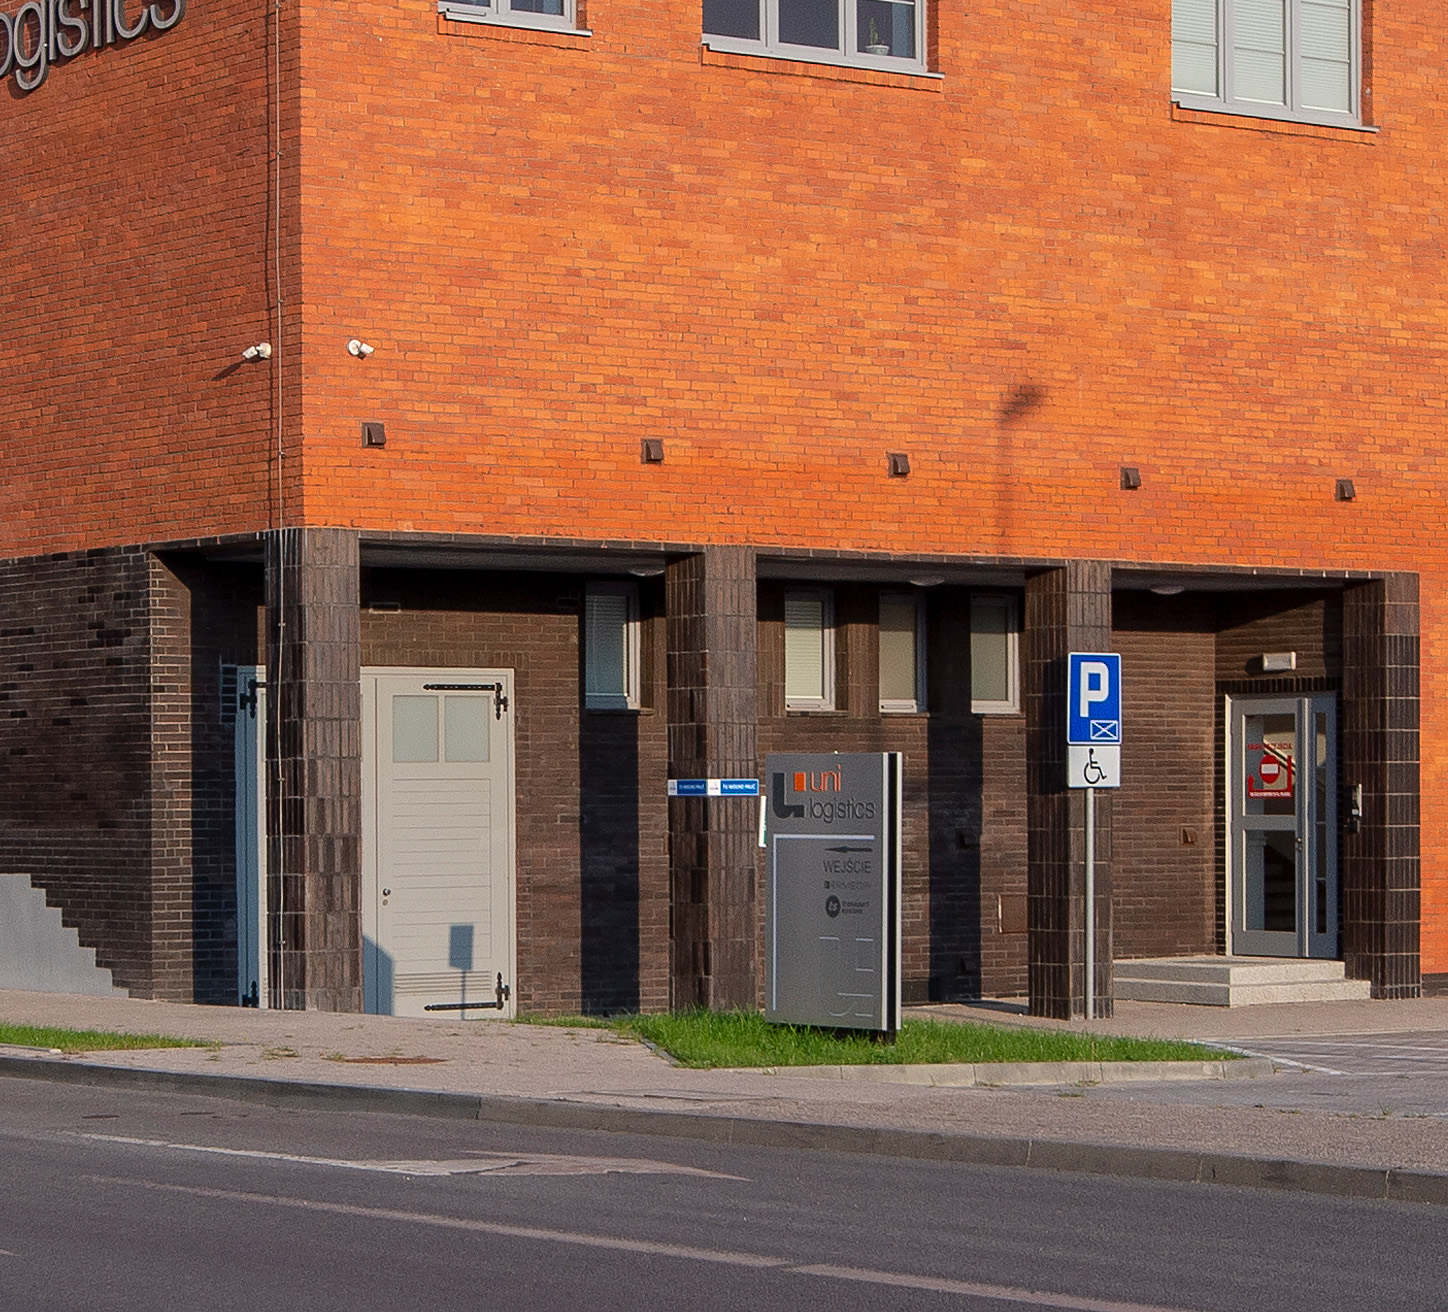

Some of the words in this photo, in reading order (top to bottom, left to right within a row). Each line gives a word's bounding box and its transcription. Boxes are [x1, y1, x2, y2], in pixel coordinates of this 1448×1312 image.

[1080, 661, 1109, 718] P
[810, 764, 842, 792] uni
[809, 797, 875, 824] logistics
[823, 857, 872, 874] WEJŚCIE
